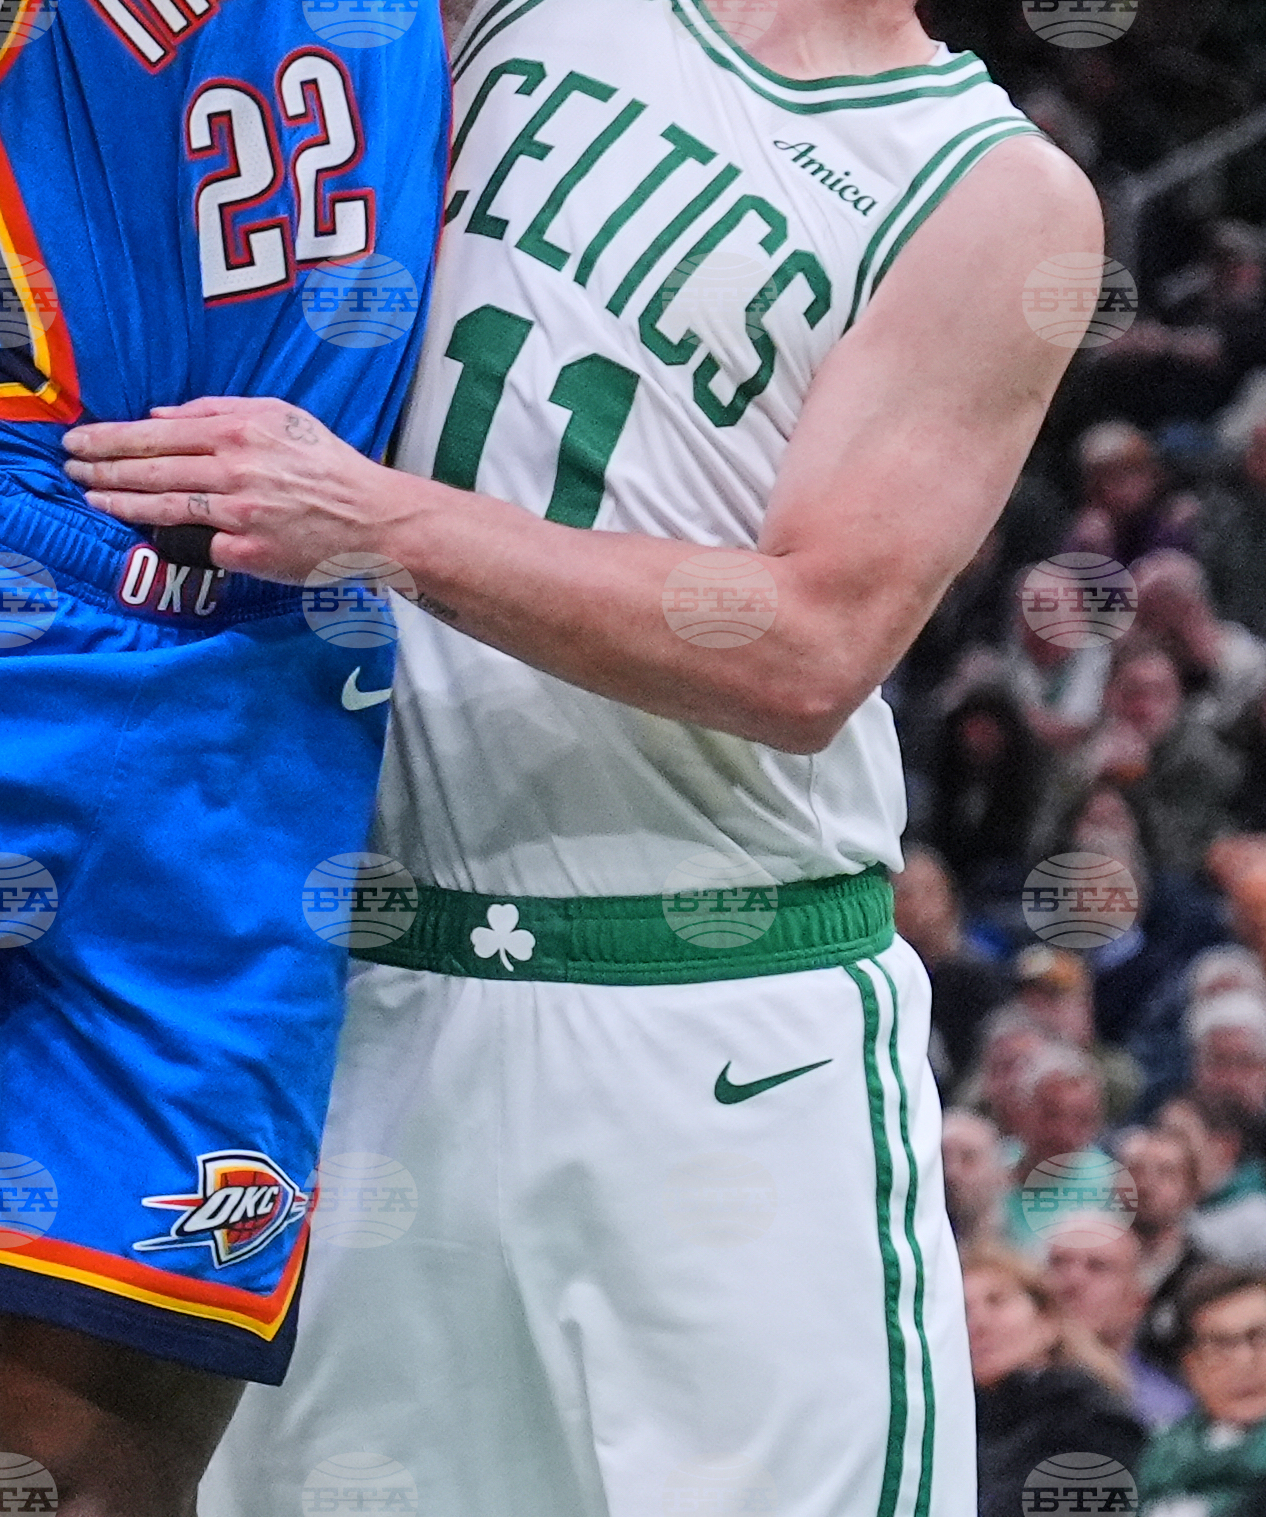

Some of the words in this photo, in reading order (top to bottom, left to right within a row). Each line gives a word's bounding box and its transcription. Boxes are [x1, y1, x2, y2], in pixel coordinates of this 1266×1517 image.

[184, 45, 375, 307] 22
[773, 140, 878, 216] Amica
[431, 303, 641, 530] 11
[120, 544, 226, 616] OKC
[183, 1185, 280, 1232] OKC
